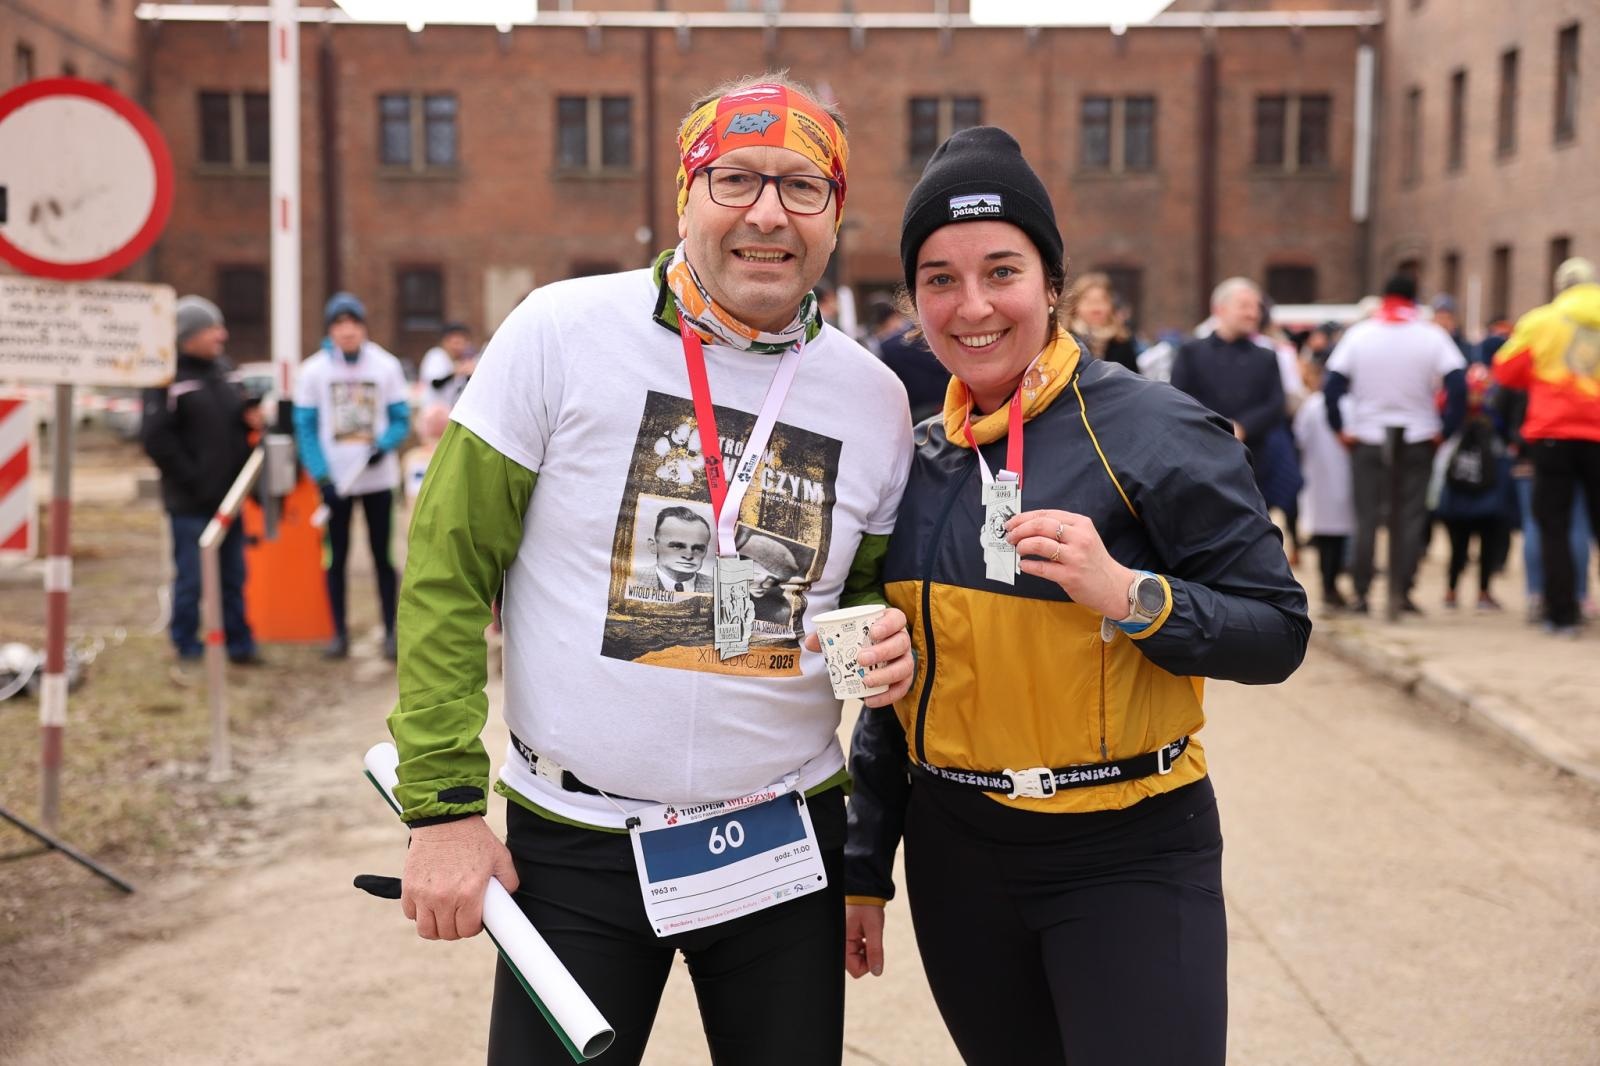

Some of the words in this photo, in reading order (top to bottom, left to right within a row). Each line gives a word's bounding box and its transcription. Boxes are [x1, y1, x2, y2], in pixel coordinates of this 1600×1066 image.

[952, 205, 1000, 218] patagonia
[628, 585, 650, 599] WITOLD
[651, 587, 675, 603] PILECKI
[769, 654, 794, 670] 2025
[680, 801, 726, 817] TROPEM
[726, 791, 777, 809] WILCZYM
[708, 820, 745, 855] 60
[774, 848, 793, 863] godz.
[793, 844, 810, 856] 11.00
[650, 886, 669, 897] 1963
[669, 885, 678, 893] m
